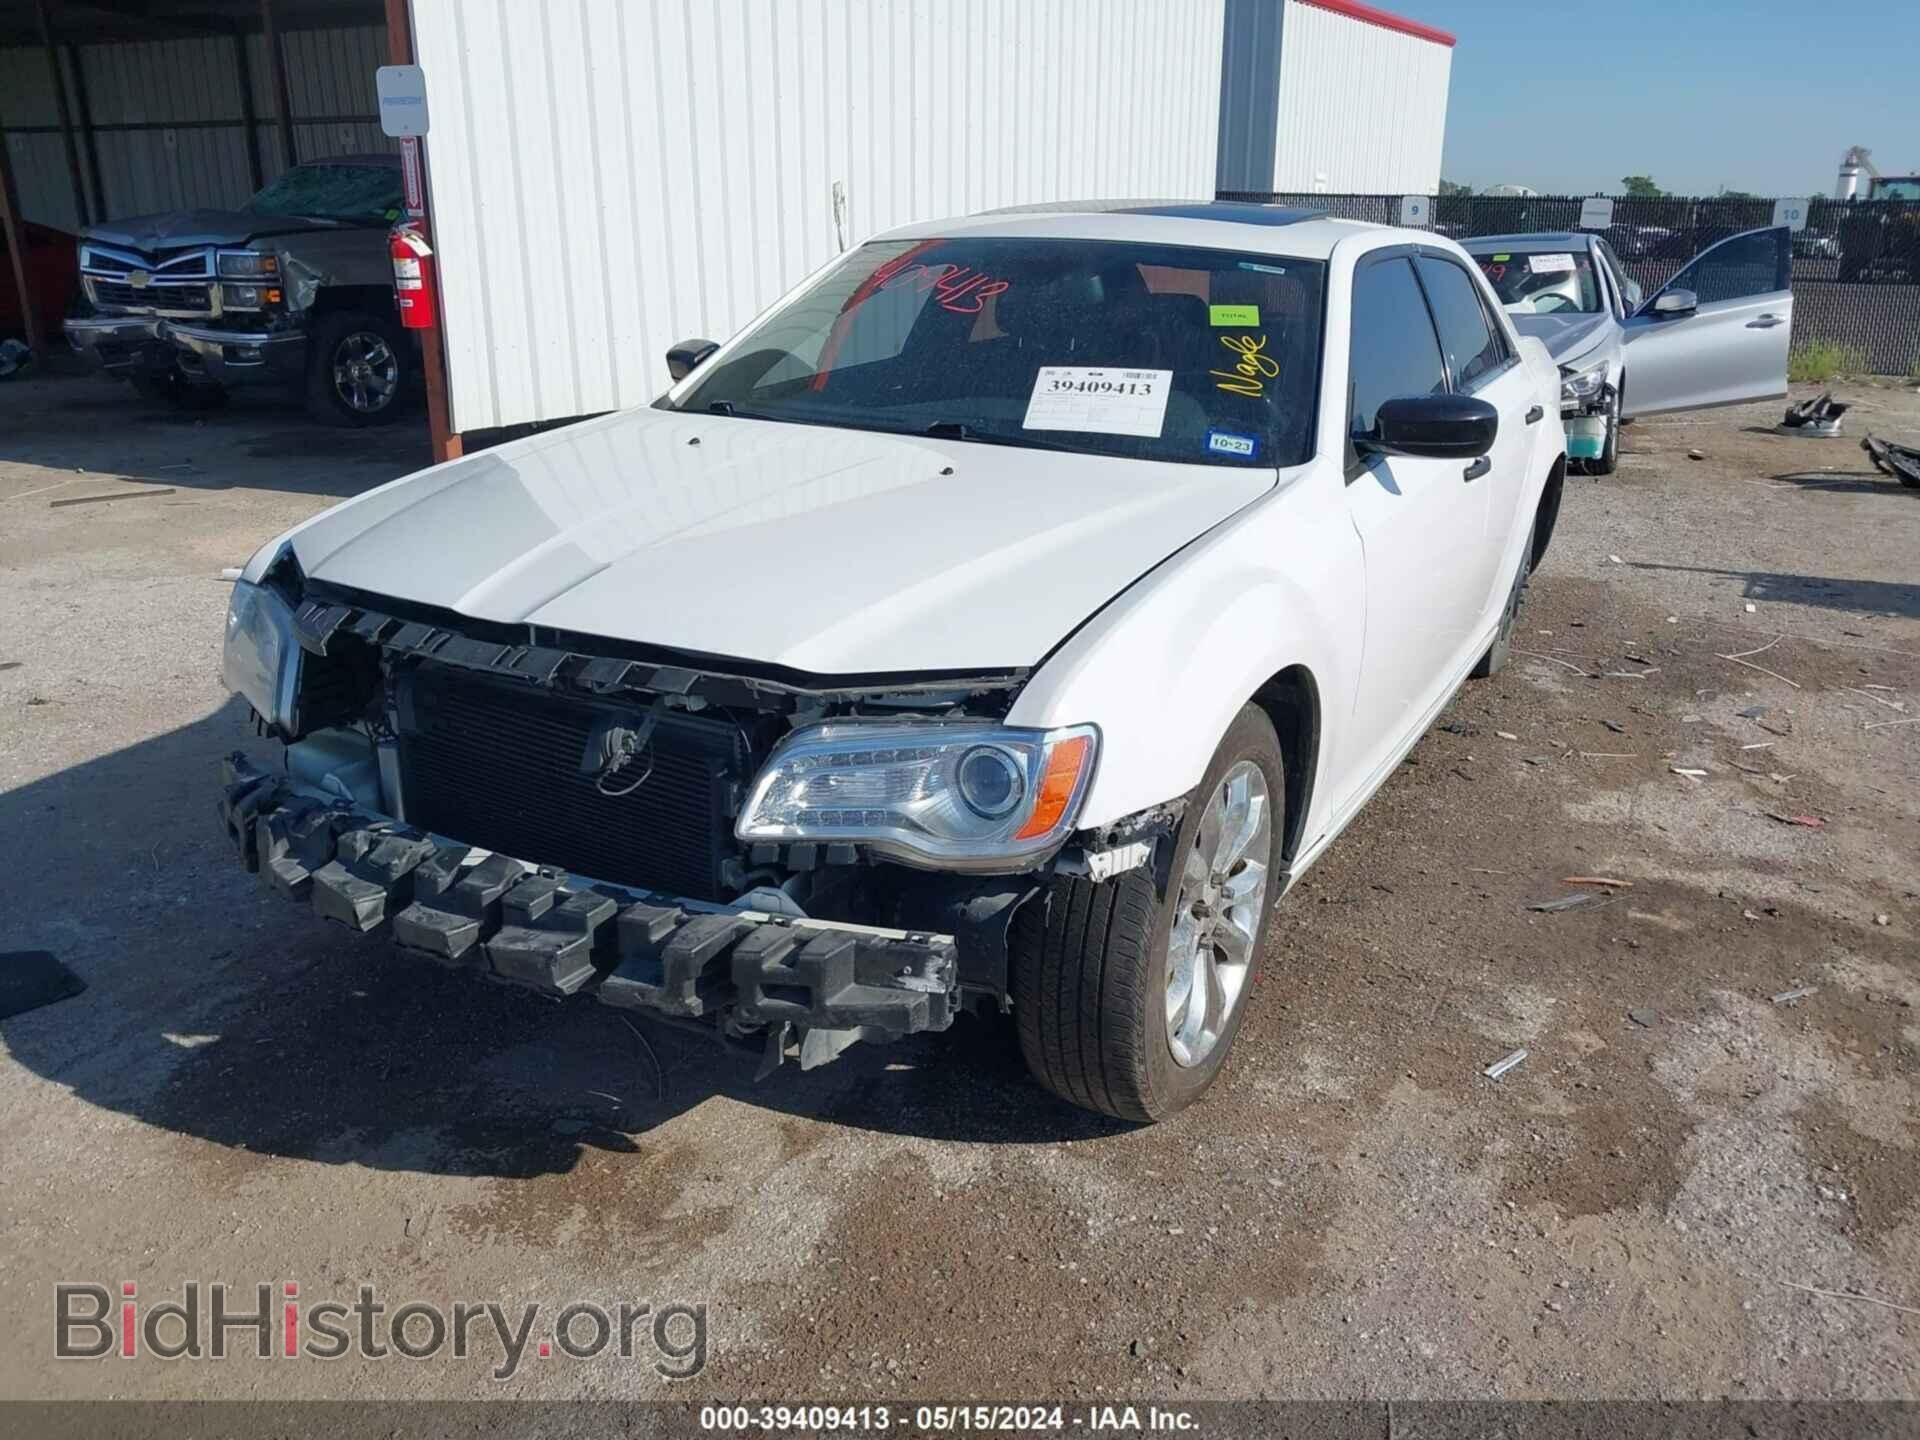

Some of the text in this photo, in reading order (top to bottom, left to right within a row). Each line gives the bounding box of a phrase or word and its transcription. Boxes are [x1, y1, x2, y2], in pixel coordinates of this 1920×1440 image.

[1411, 205, 1420, 216] 9
[1783, 209, 1800, 220] 10
[1209, 334, 1280, 397] Nagle
[1047, 379, 1152, 396] 39409413
